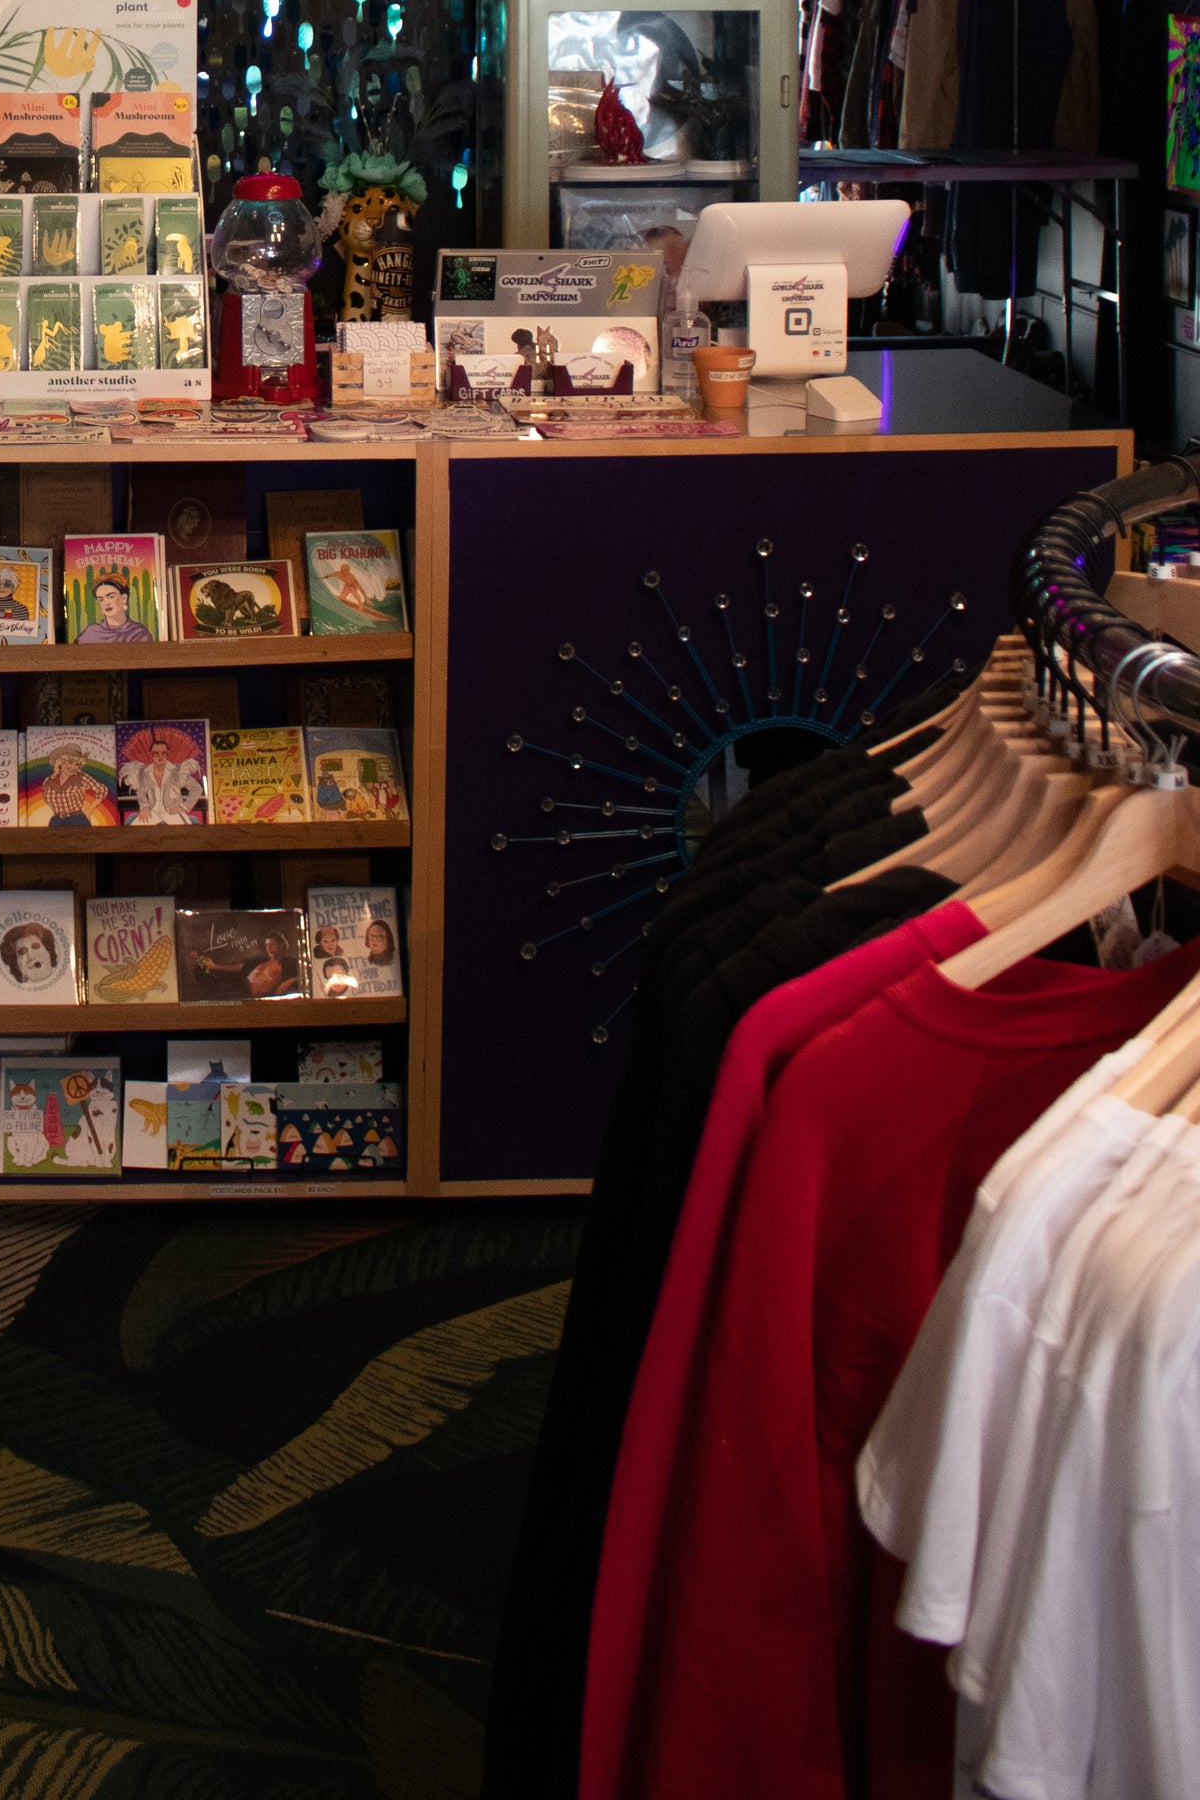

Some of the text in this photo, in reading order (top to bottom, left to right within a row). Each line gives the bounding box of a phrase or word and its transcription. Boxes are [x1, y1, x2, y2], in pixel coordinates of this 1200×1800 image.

[117, 2, 148, 14] plant
[21, 103, 45, 111] Mini
[133, 103, 157, 111] Mini
[3, 112, 63, 121] Mushrooms
[115, 112, 175, 120] Mushrooms
[502, 277, 593, 286] GOBLIN SHARK
[520, 294, 578, 302] EMPORIUM
[48, 375, 137, 387] another studio
[492, 387, 526, 400] CARDS
[83, 542, 135, 554] HAPPY
[316, 548, 387, 560] BIG KAHUNA
[75, 554, 144, 568] BIRTHDAY
[202, 566, 267, 577] YOU WERE BORN
[1152, 568, 1158, 577] S
[237, 756, 278, 767] HAVE A
[228, 766, 287, 780] TASTY
[232, 778, 284, 787] BIRTHDAY
[90, 900, 137, 916] YOU MAKE
[101, 914, 136, 930] ME SO
[94, 907, 162, 963] CORNY!
